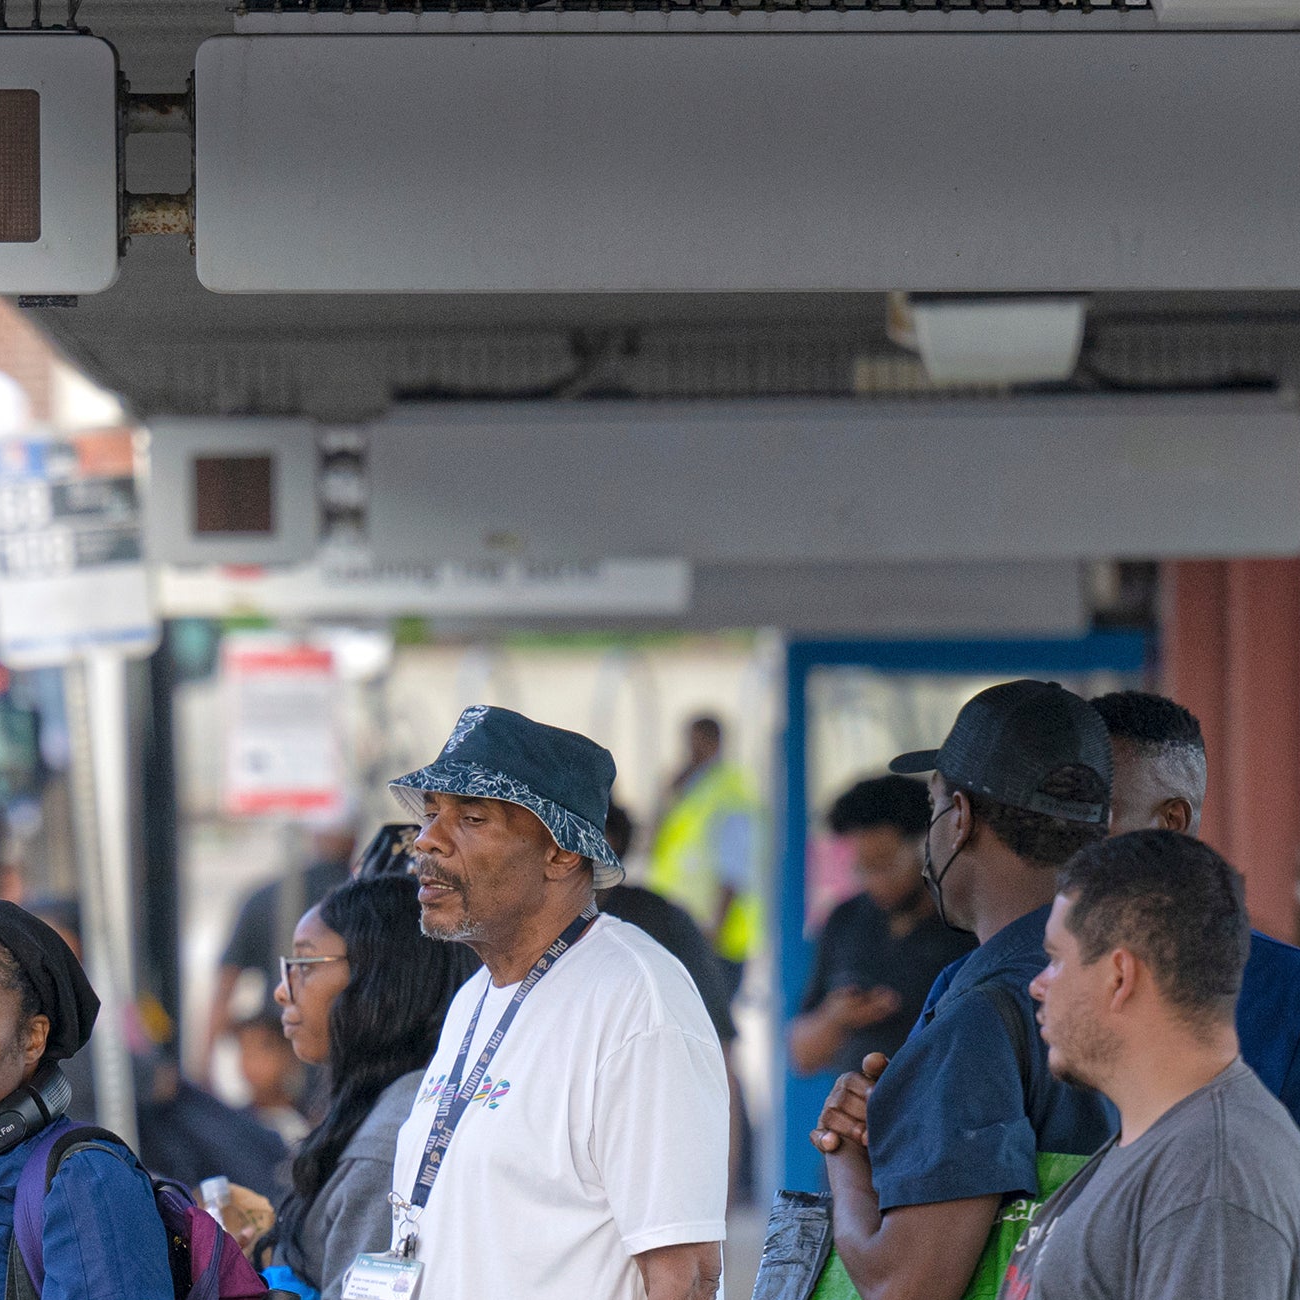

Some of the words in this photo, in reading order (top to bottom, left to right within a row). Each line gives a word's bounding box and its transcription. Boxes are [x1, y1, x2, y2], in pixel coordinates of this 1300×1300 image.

[547, 938, 568, 957] PHL
[513, 966, 542, 1003] UNION
[487, 1029, 503, 1050] PHL
[460, 1061, 486, 1100] UNION
[0, 1124, 15, 1135] Fan
